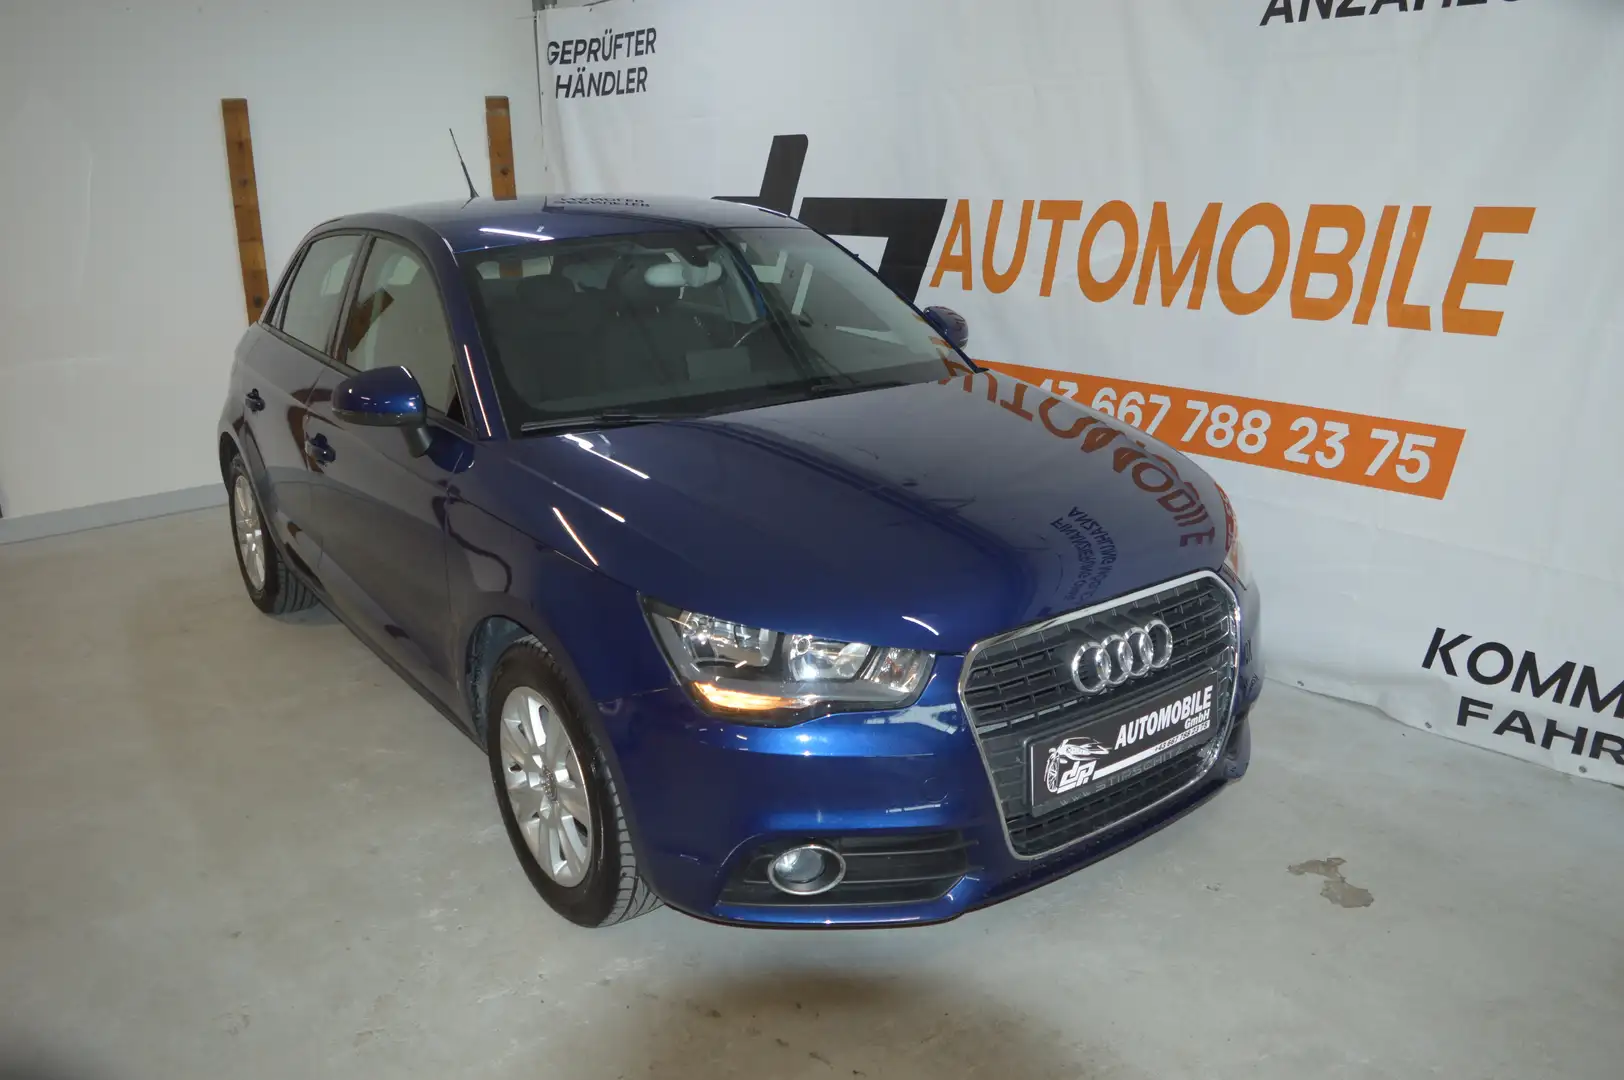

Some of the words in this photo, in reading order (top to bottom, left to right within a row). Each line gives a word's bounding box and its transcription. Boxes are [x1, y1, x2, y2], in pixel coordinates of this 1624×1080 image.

[547, 27, 657, 65] GEPRÜFTER
[556, 66, 648, 99] HÄNDLER
[929, 199, 1537, 337] AUTOMOBILE
[1180, 400, 1272, 455] 788
[1283, 417, 1350, 469] 23
[1364, 428, 1437, 484] 75
[1115, 685, 1214, 750] AUTOMOBILE
[1184, 708, 1211, 730] GmbH
